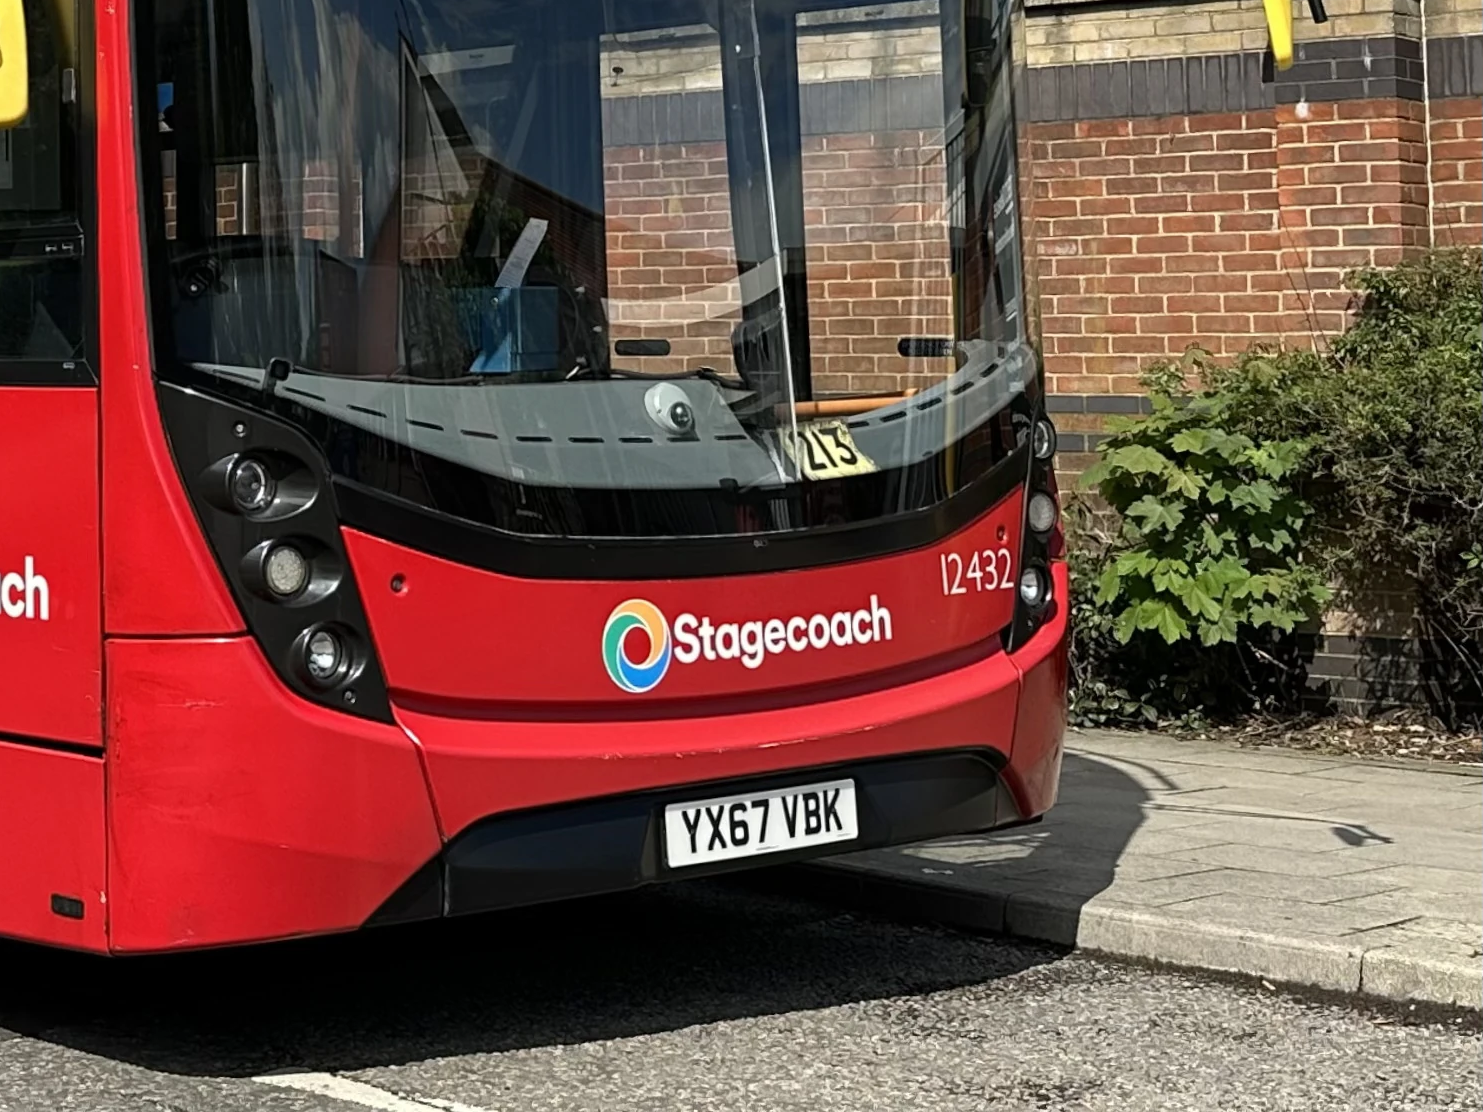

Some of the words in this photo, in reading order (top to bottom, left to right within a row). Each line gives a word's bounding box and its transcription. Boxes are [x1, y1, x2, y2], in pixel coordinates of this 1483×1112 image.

[788, 426, 858, 471] 213
[940, 547, 1015, 596] 12432
[673, 593, 893, 669] Stagecoach
[681, 798, 769, 854] YX67
[781, 787, 843, 839] VBK
